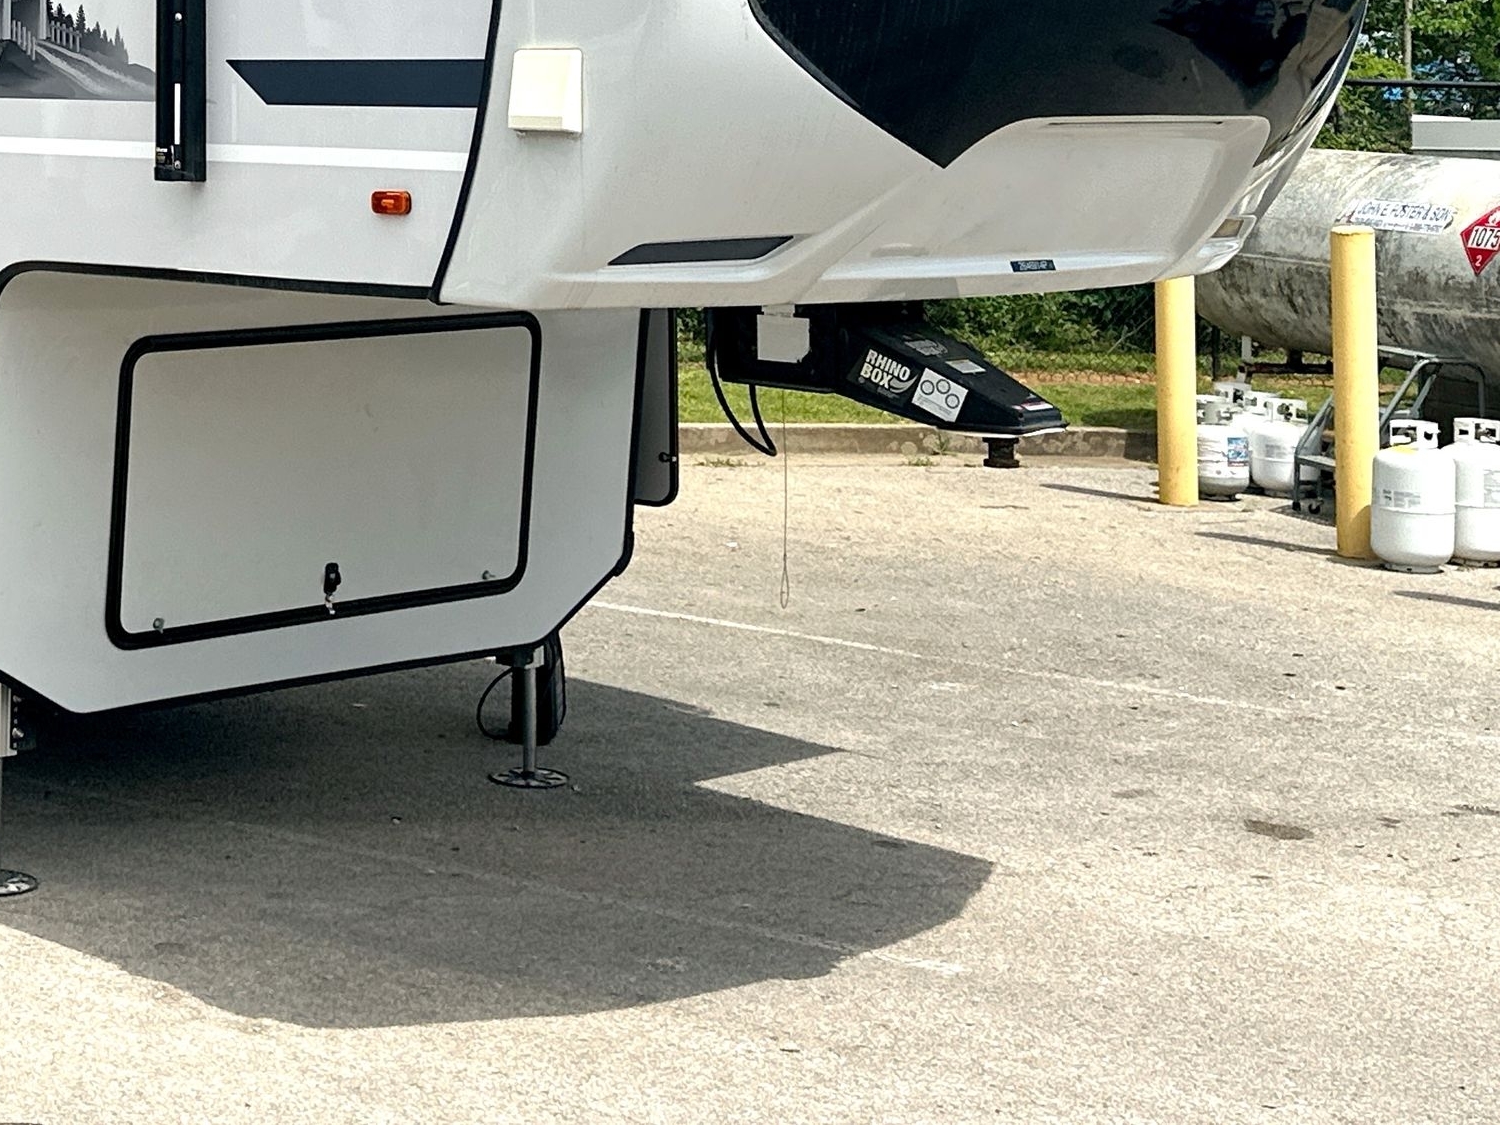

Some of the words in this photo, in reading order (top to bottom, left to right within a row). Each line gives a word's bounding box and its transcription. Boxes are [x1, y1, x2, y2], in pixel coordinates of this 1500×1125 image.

[1470, 227, 1500, 249] 1075
[1475, 254, 1483, 267] 2
[860, 362, 894, 390] BOX
[866, 349, 910, 381] RHINO
